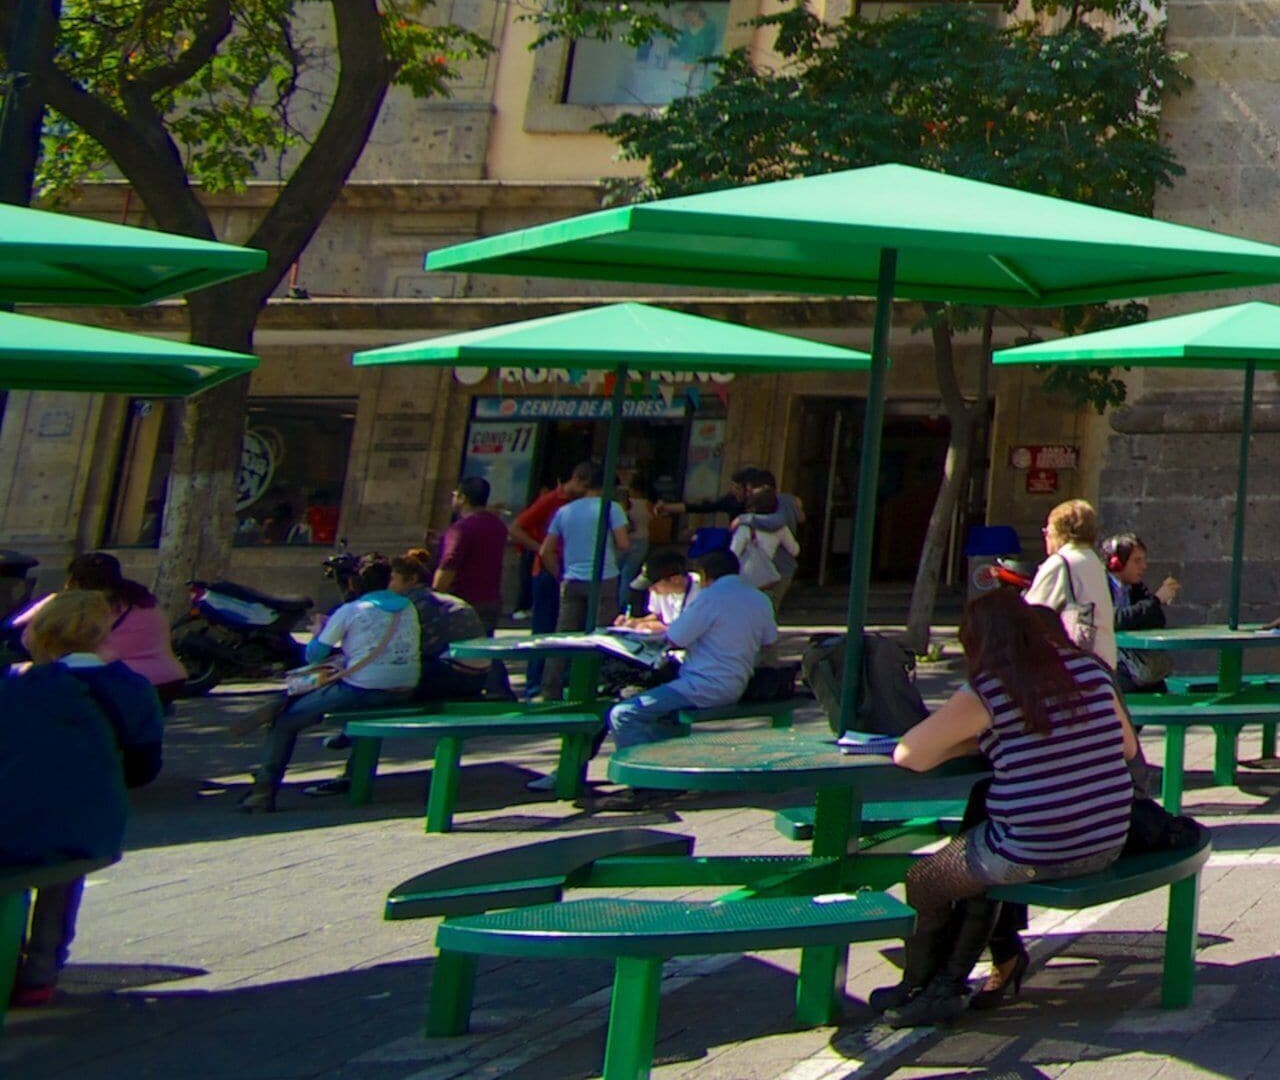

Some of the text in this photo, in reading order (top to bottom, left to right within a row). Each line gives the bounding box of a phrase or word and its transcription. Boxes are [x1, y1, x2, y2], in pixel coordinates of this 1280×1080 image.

[520, 399, 664, 417] CENTRO DE PSTRES
